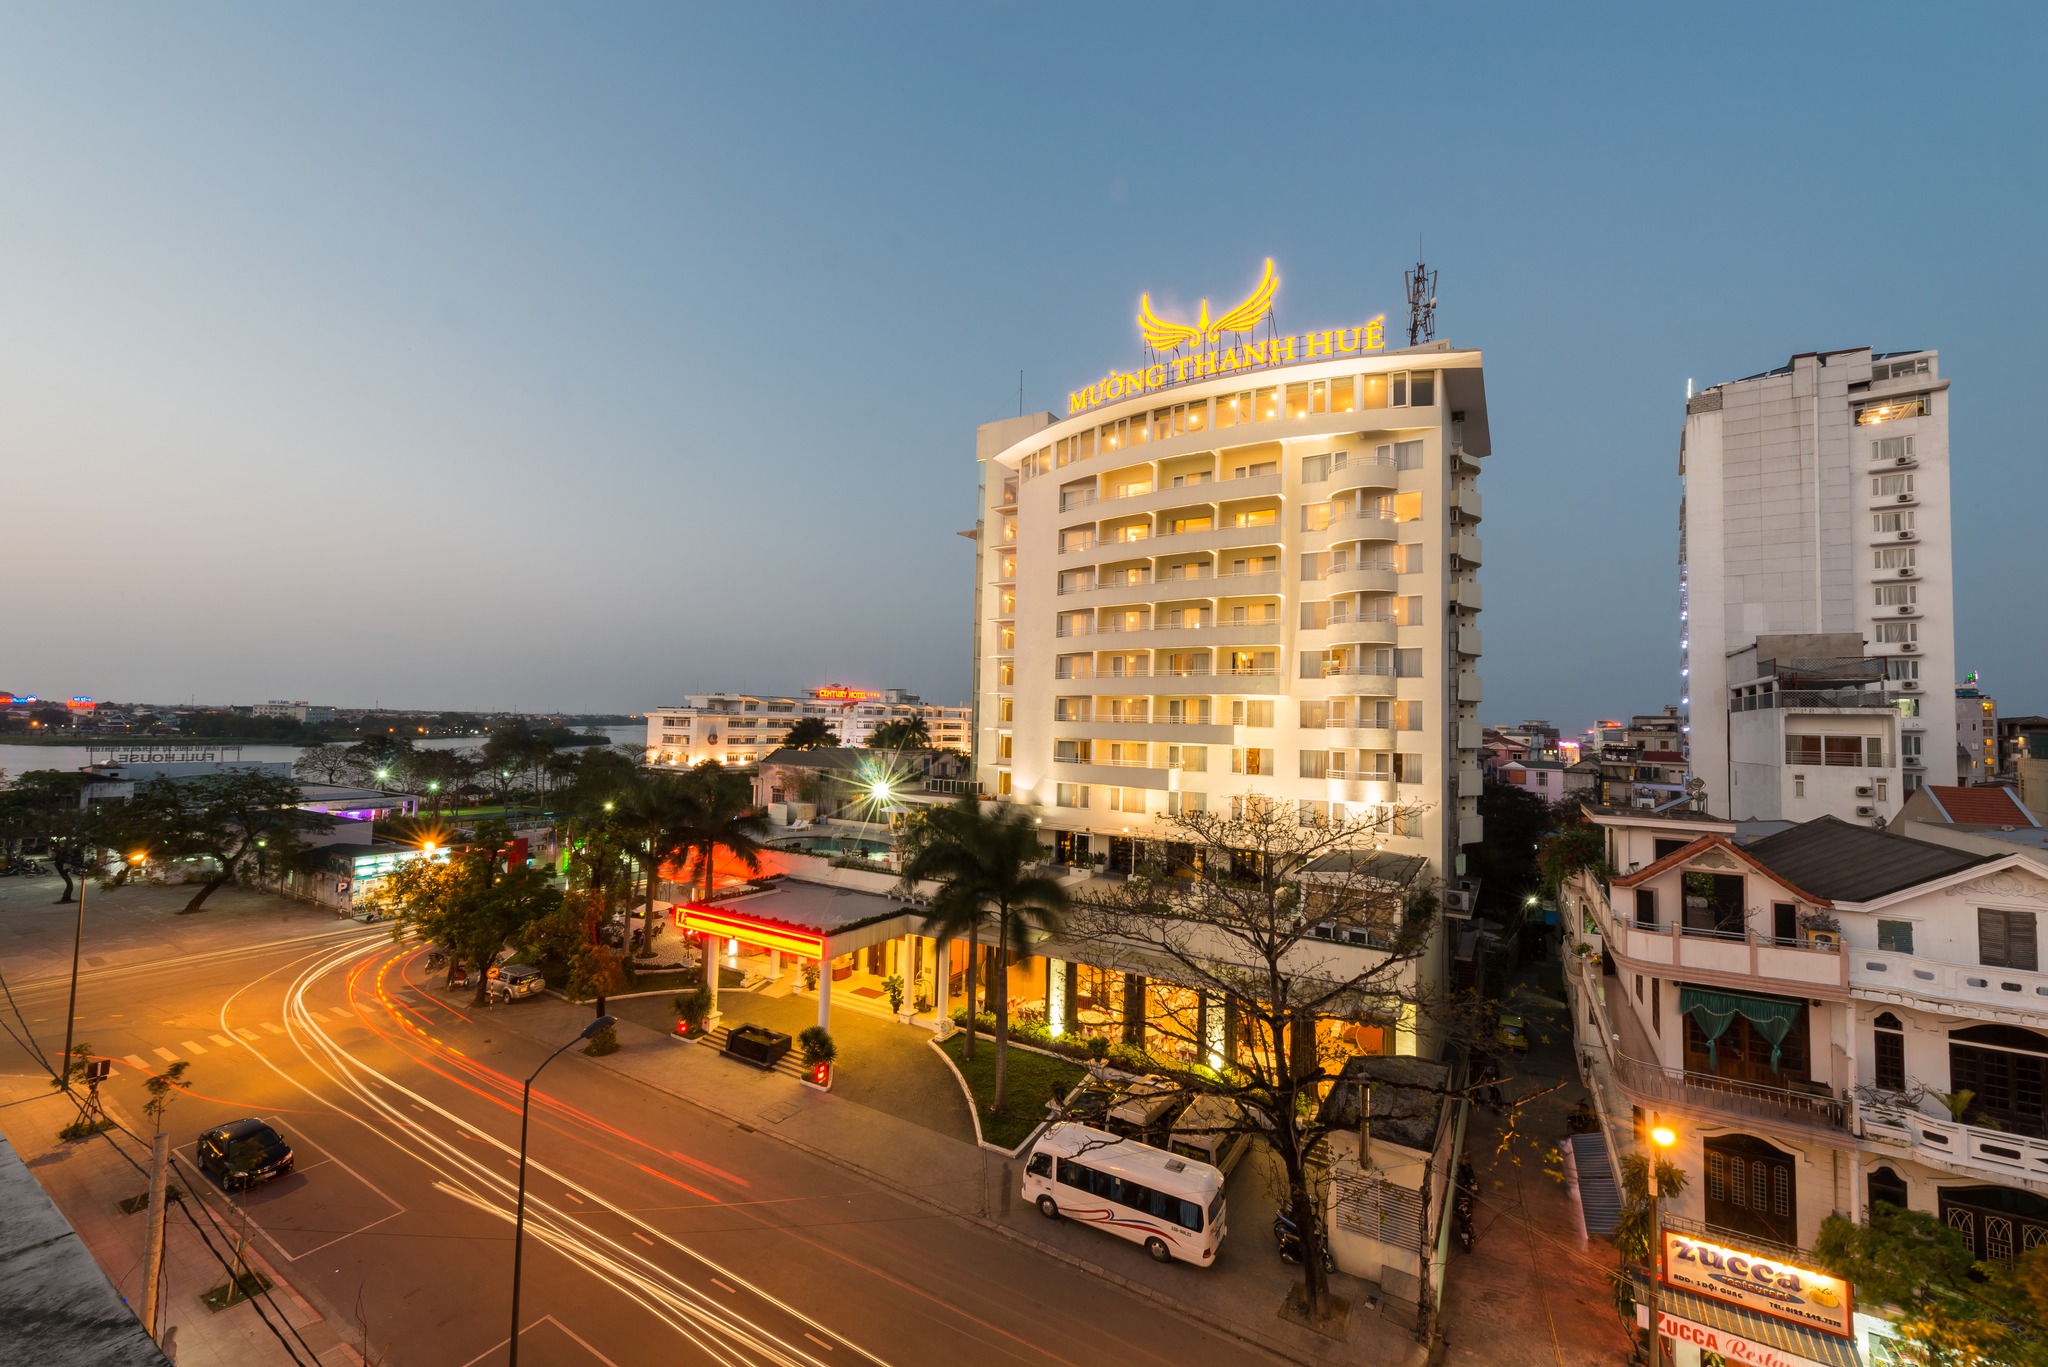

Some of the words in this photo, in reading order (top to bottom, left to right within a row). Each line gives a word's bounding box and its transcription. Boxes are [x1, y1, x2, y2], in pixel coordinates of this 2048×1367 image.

[1068, 363, 1165, 413] MƯỜNG
[1171, 336, 1296, 382] THANH
[1304, 313, 1386, 358] HUẾ
[819, 689, 847, 698] CENTURY
[848, 690, 867, 699] HOTEL
[338, 882, 348, 893] P
[1721, 1276, 1790, 1302] restaurant
[1658, 1310, 1718, 1351] ZUCCA
